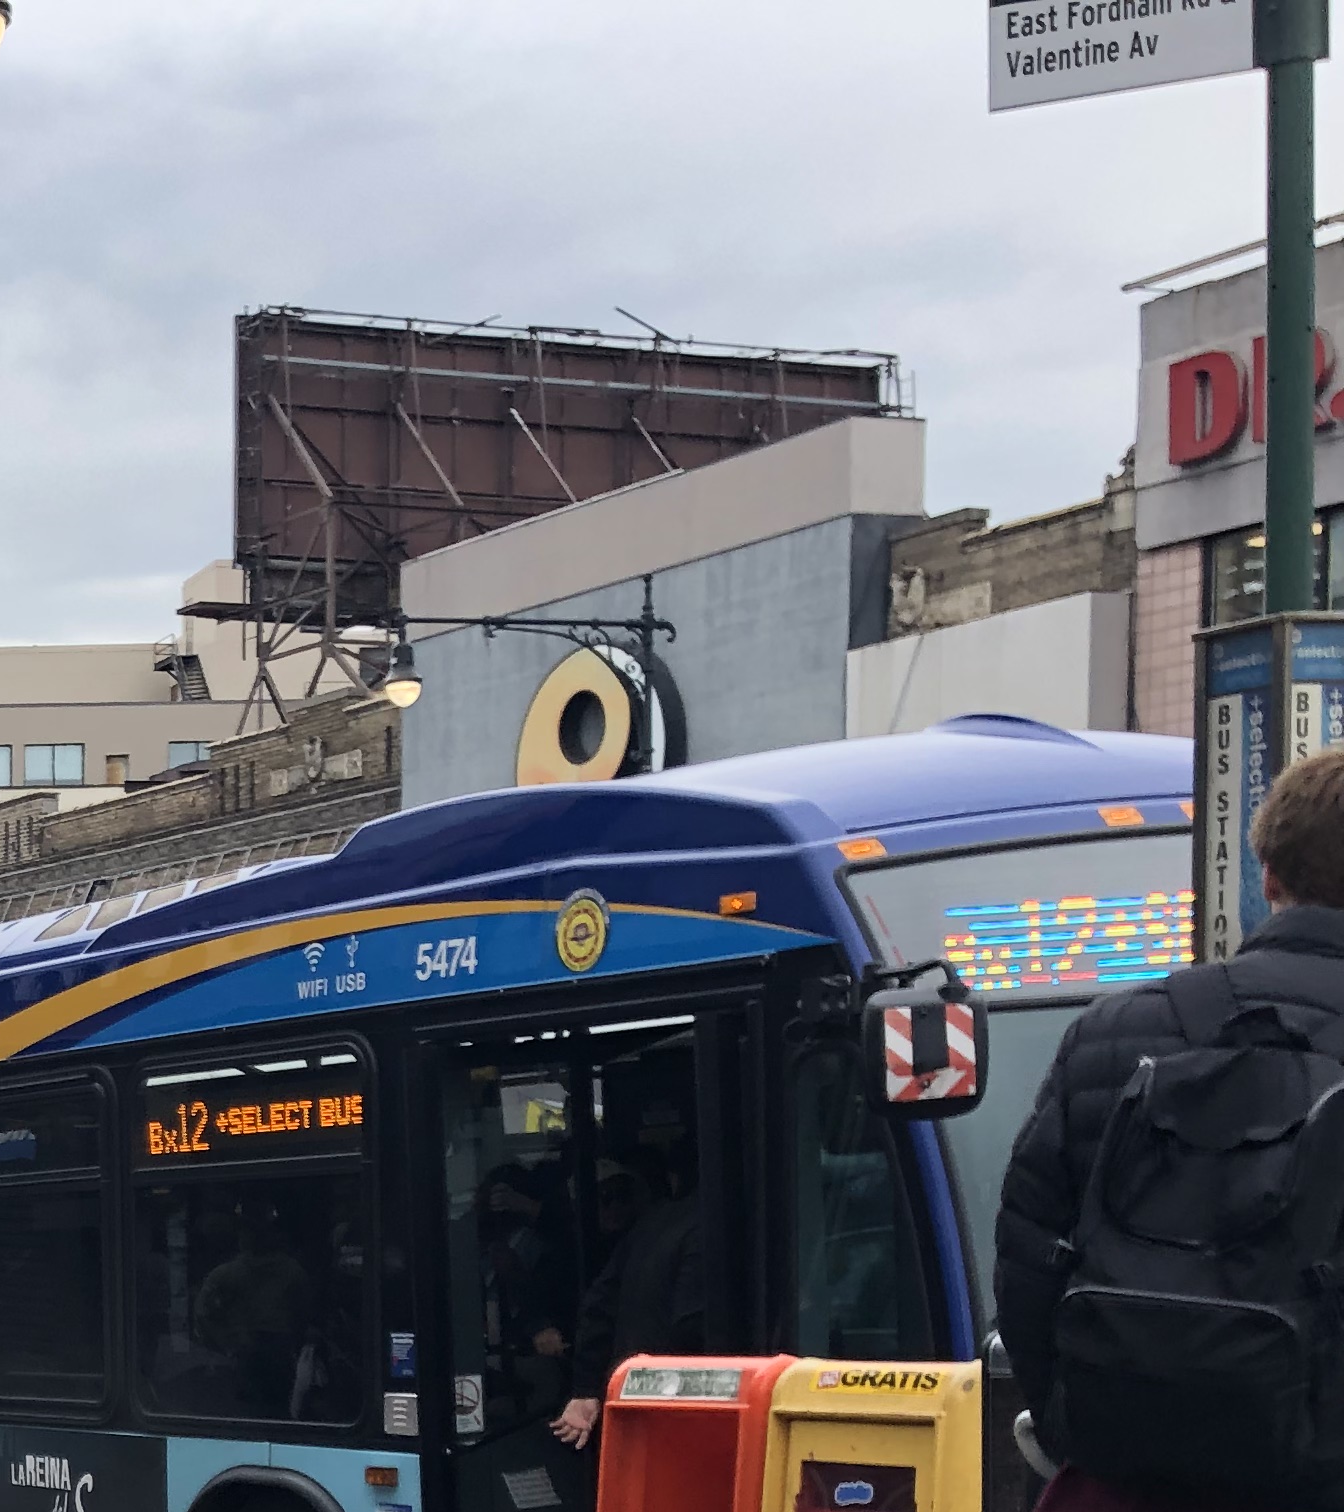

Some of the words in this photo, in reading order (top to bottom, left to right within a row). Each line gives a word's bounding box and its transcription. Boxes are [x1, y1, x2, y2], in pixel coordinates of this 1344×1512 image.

[1006, 5, 1058, 40] East
[1006, 38, 1120, 78] Valentine
[1128, 31, 1160, 60] Av
[1217, 702, 1231, 776] BUS
[1213, 789, 1230, 961] STATION
[415, 935, 478, 983] 5474
[297, 978, 328, 1000] WIFI
[335, 971, 367, 994] USB
[148, 1100, 210, 1155] Bx12
[318, 1093, 364, 1129] BUS
[840, 1370, 940, 1392] GRATIS
[10, 1462, 26, 1487] LA
[25, 1454, 72, 1491] REINA
